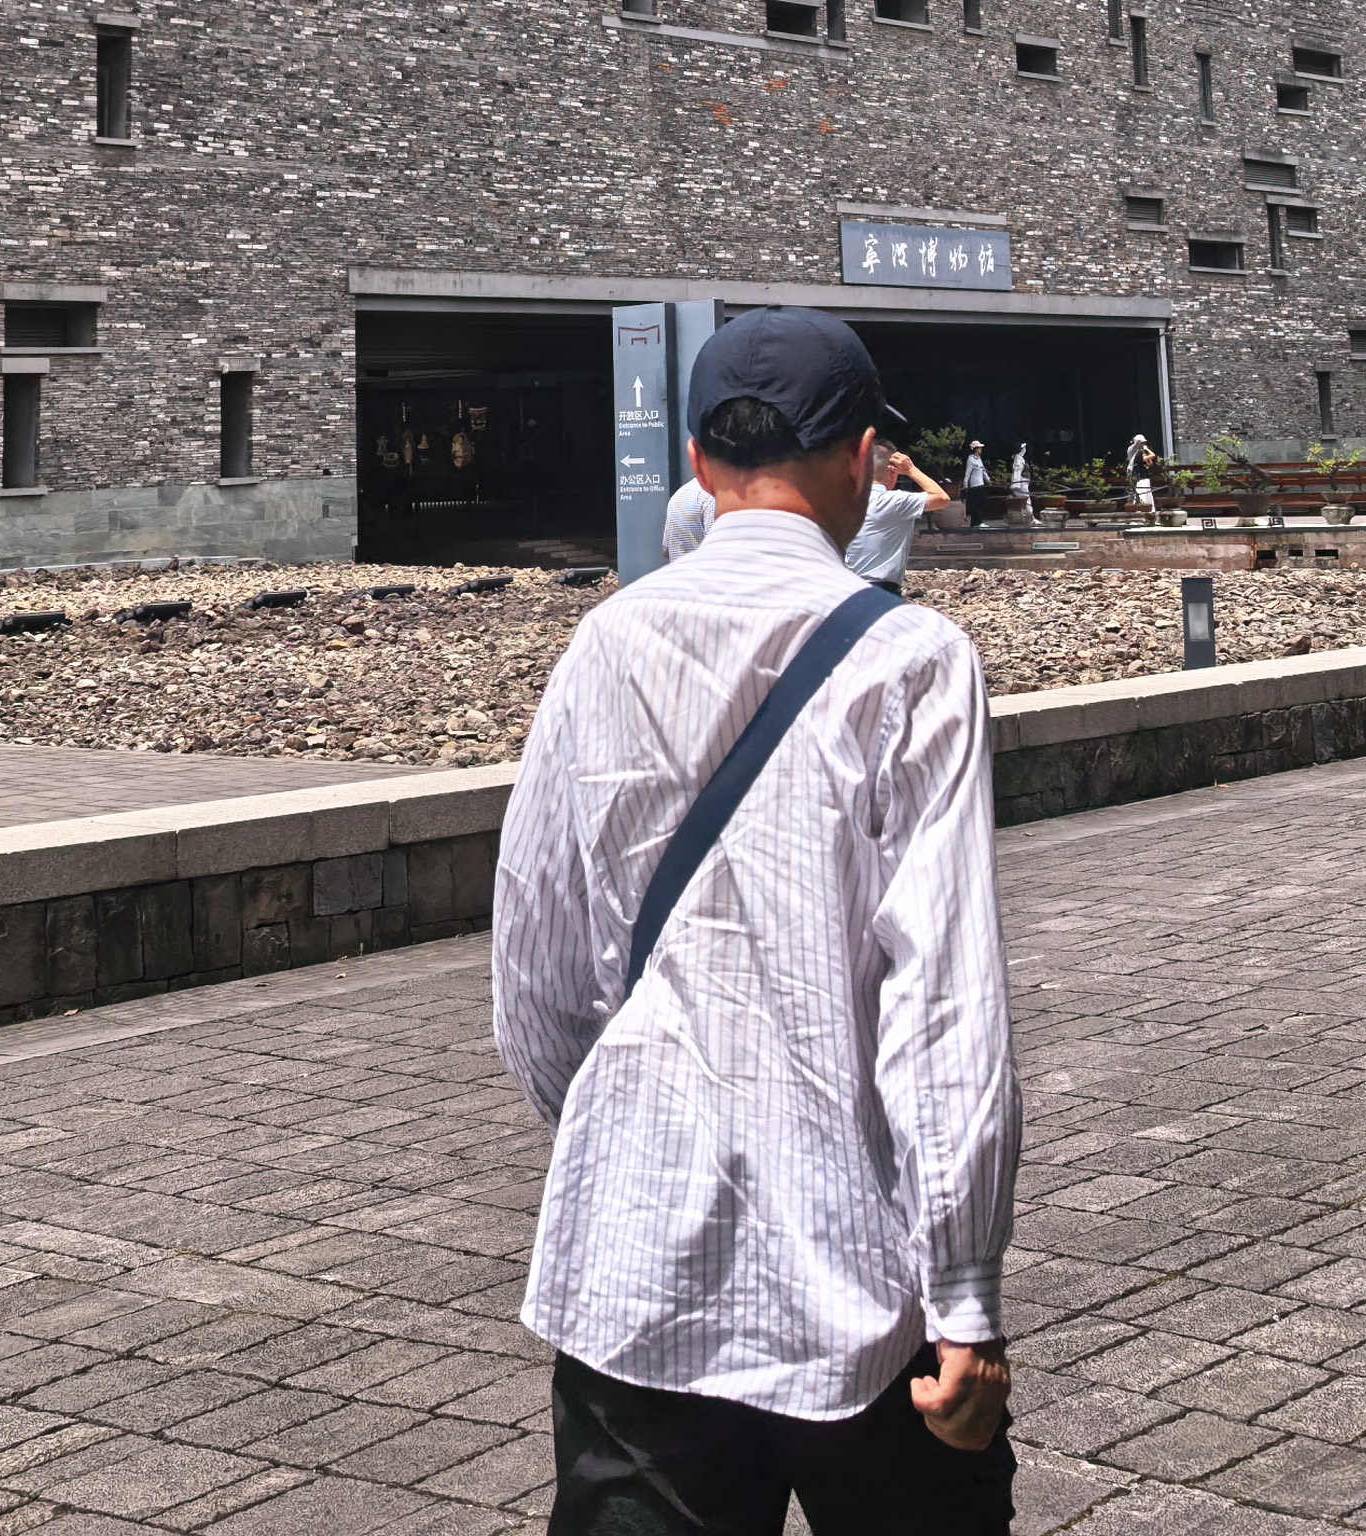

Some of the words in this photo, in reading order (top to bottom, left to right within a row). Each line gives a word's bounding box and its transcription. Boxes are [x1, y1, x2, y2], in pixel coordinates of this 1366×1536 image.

[619, 410, 659, 421] 开放区入口
[619, 474, 660, 485] 办公区入口
